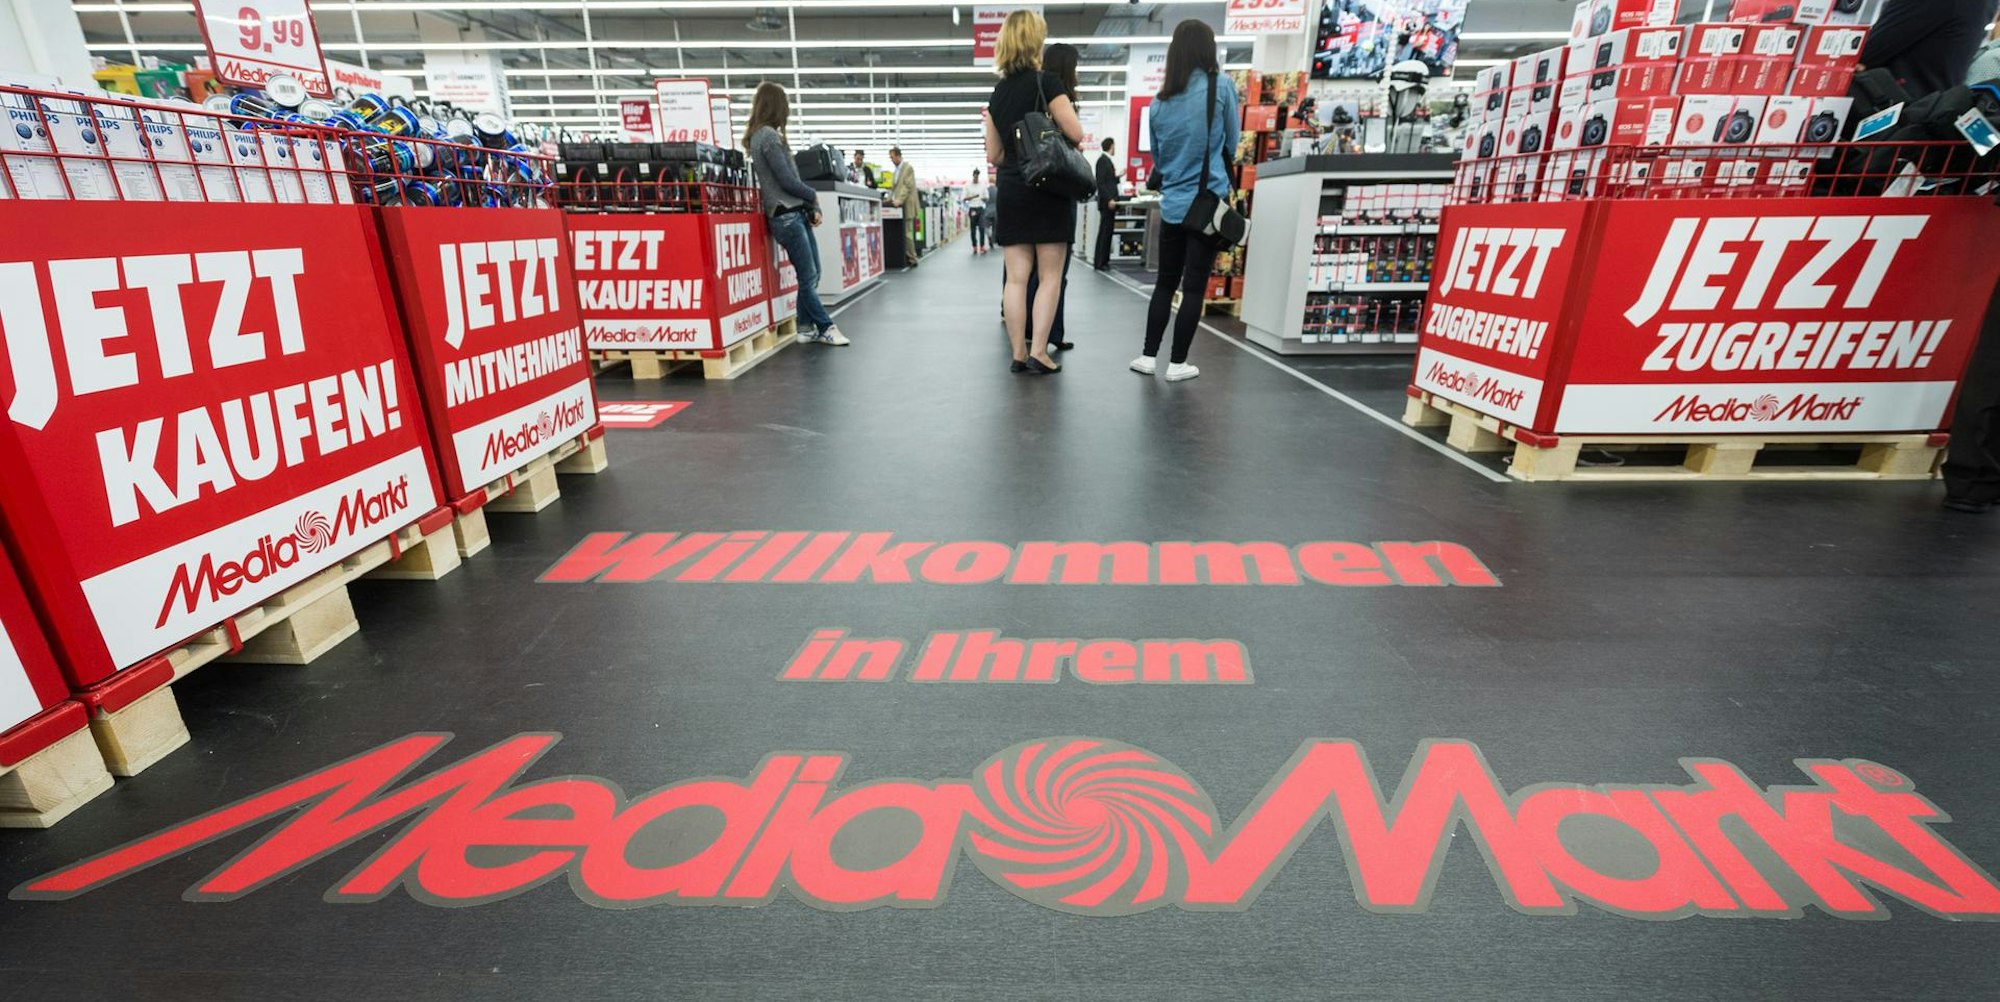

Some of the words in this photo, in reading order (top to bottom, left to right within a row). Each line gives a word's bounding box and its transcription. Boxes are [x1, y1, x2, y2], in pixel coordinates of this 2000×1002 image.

[237, 6, 304, 53] 9.99
[187, 129, 221, 140] PHILIPS
[569, 230, 664, 270] ETZT
[714, 222, 750, 279] JETZT
[1440, 226, 1566, 299] JETZT
[1624, 215, 1930, 327] JETZT
[439, 237, 559, 350] JETZT
[578, 278, 703, 310] KAUFEN!
[727, 267, 762, 305] KAUFEN!
[0, 248, 305, 431] JETZT
[587, 326, 636, 344] Media
[649, 326, 697, 343] Markt
[1426, 302, 1548, 360] ZUGREIFEN!
[1641, 319, 1953, 371] ZUGREIFEN!
[443, 327, 582, 408] MITNEHMEN!
[1425, 361, 1467, 393] Media
[1475, 377, 1526, 411] Markt
[481, 412, 539, 471] Media
[552, 396, 585, 435] Markt
[1653, 393, 1751, 422] Media
[1771, 396, 1863, 422] Markt
[95, 358, 401, 528] KAUFEN!
[154, 530, 299, 629] Media
[329, 475, 408, 546] Markt
[541, 531, 1497, 586] Willkommen
[781, 629, 900, 680] in
[909, 631, 1247, 682] Ihrem
[28, 735, 973, 904] Media
[1188, 741, 2000, 914] Markt
